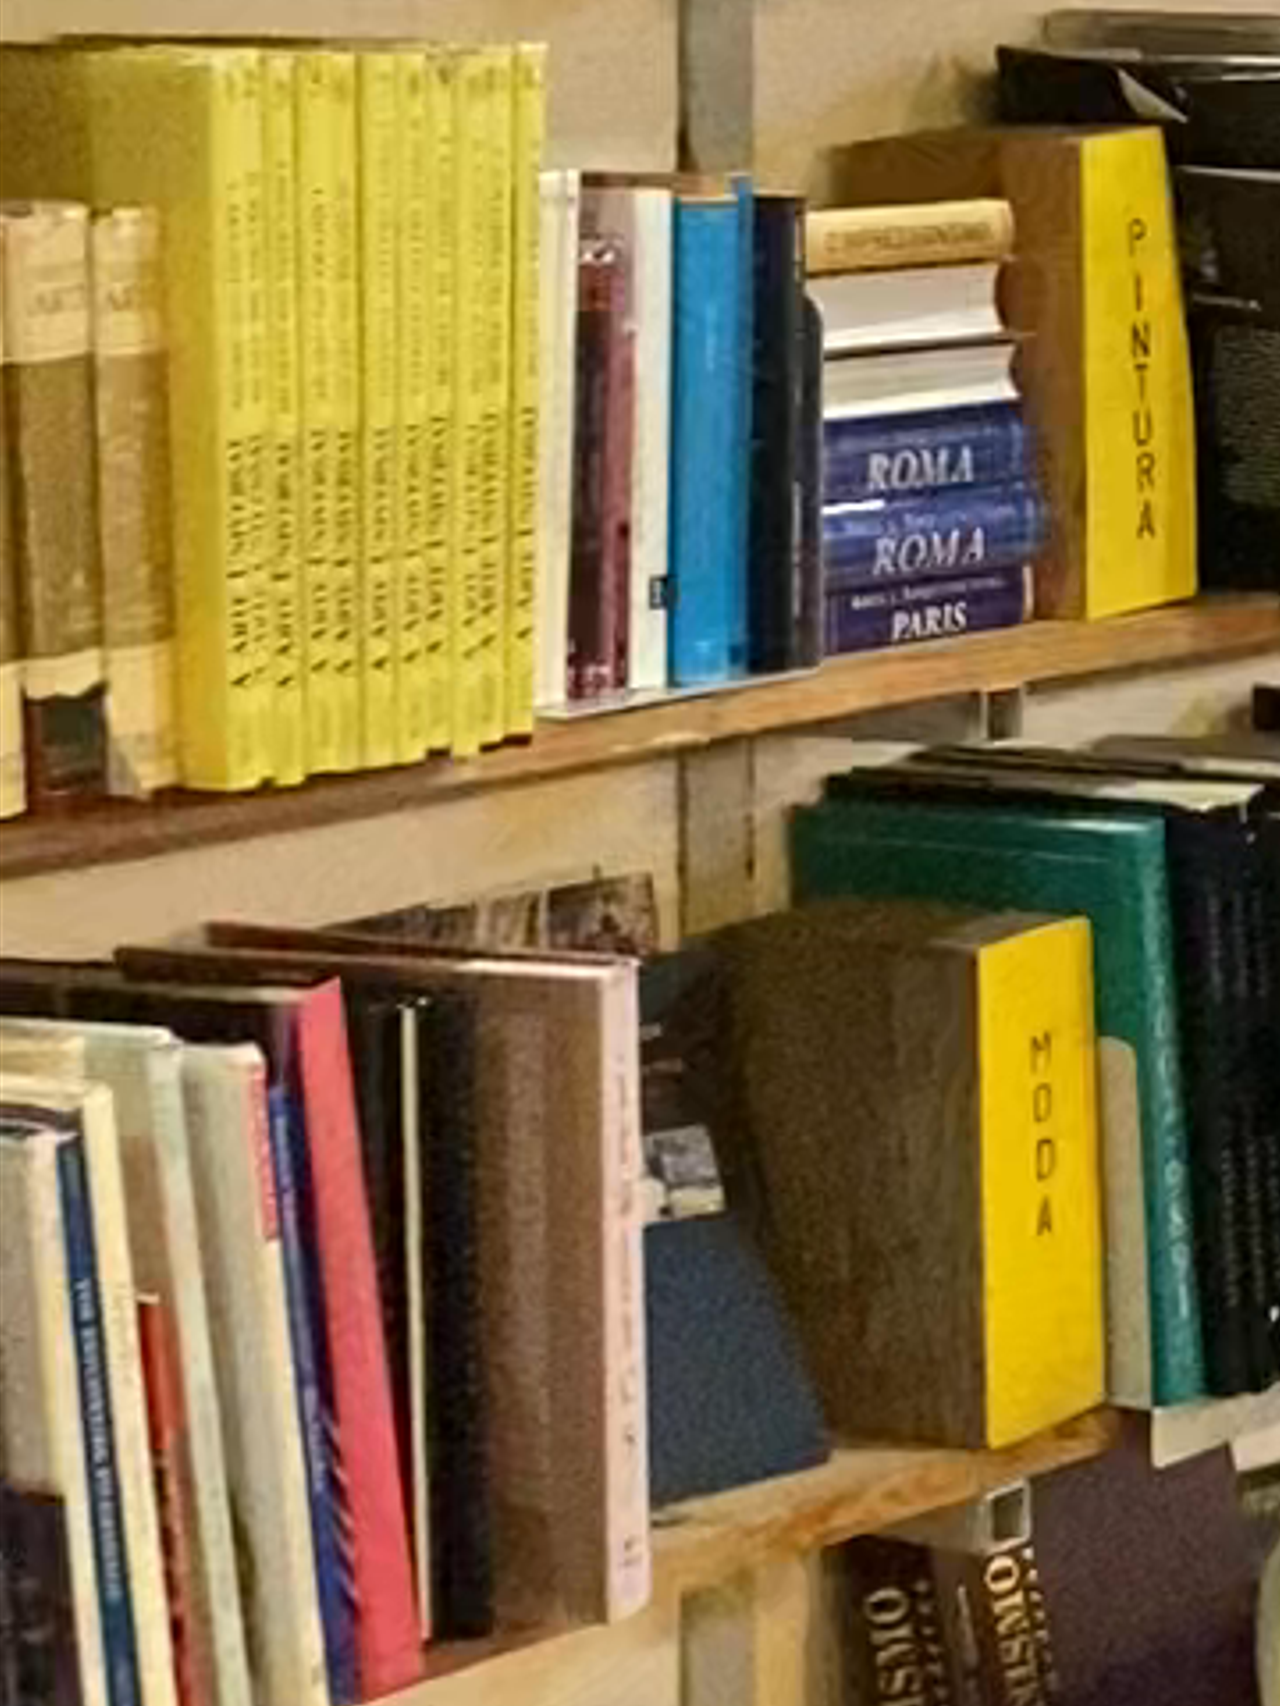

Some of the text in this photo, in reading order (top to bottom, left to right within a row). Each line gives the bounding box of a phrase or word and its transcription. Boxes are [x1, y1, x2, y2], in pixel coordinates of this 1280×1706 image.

[1126, 217, 1156, 540] PINTURA
[867, 445, 976, 493] ROMA
[873, 525, 987, 577] ROMA
[891, 600, 968, 643] PARIS
[1028, 1032, 1056, 1238] MODA
